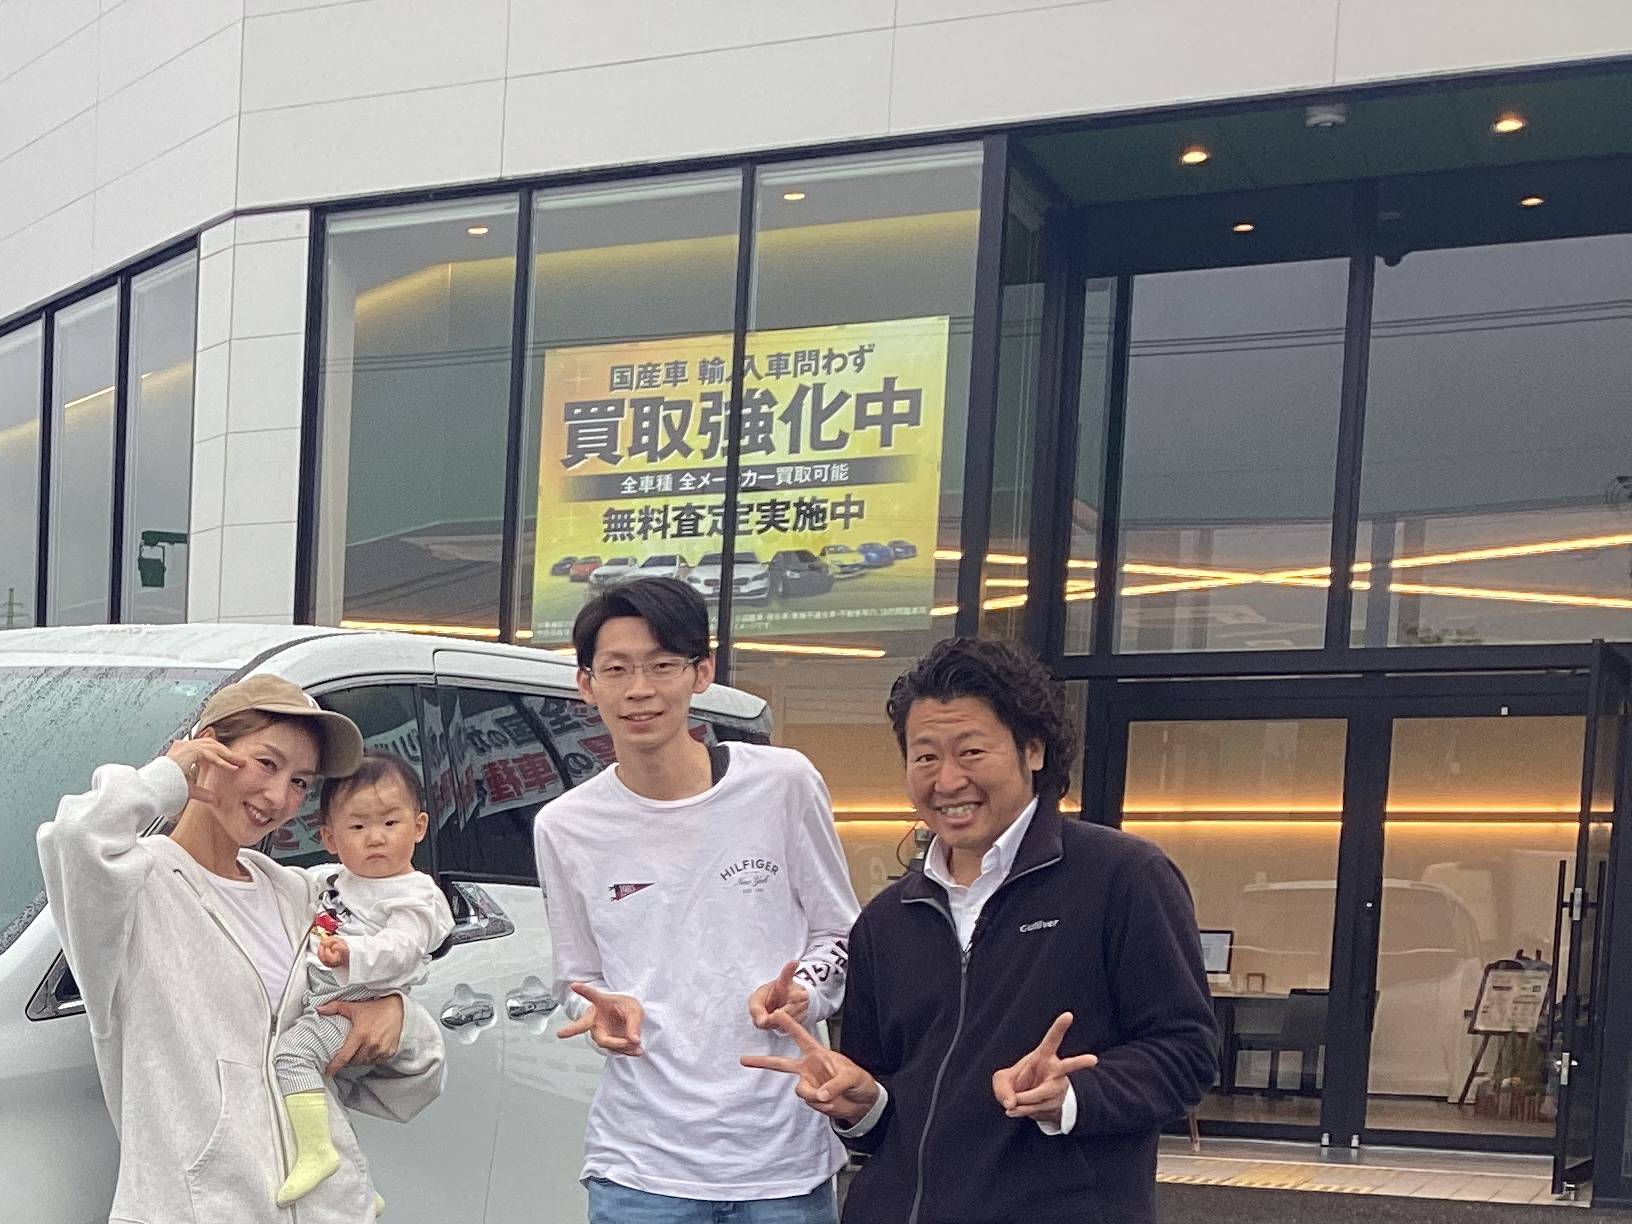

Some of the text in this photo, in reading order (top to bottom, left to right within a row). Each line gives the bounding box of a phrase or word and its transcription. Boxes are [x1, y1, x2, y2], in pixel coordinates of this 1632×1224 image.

[609, 344, 875, 392] 国産車 輸入車問わず
[560, 376, 922, 469] 買取強化中
[621, 463, 850, 494] 全車種 全メーカー買取可能
[602, 493, 866, 543] 無料査定実施中
[720, 859, 779, 881] HILFIGER
